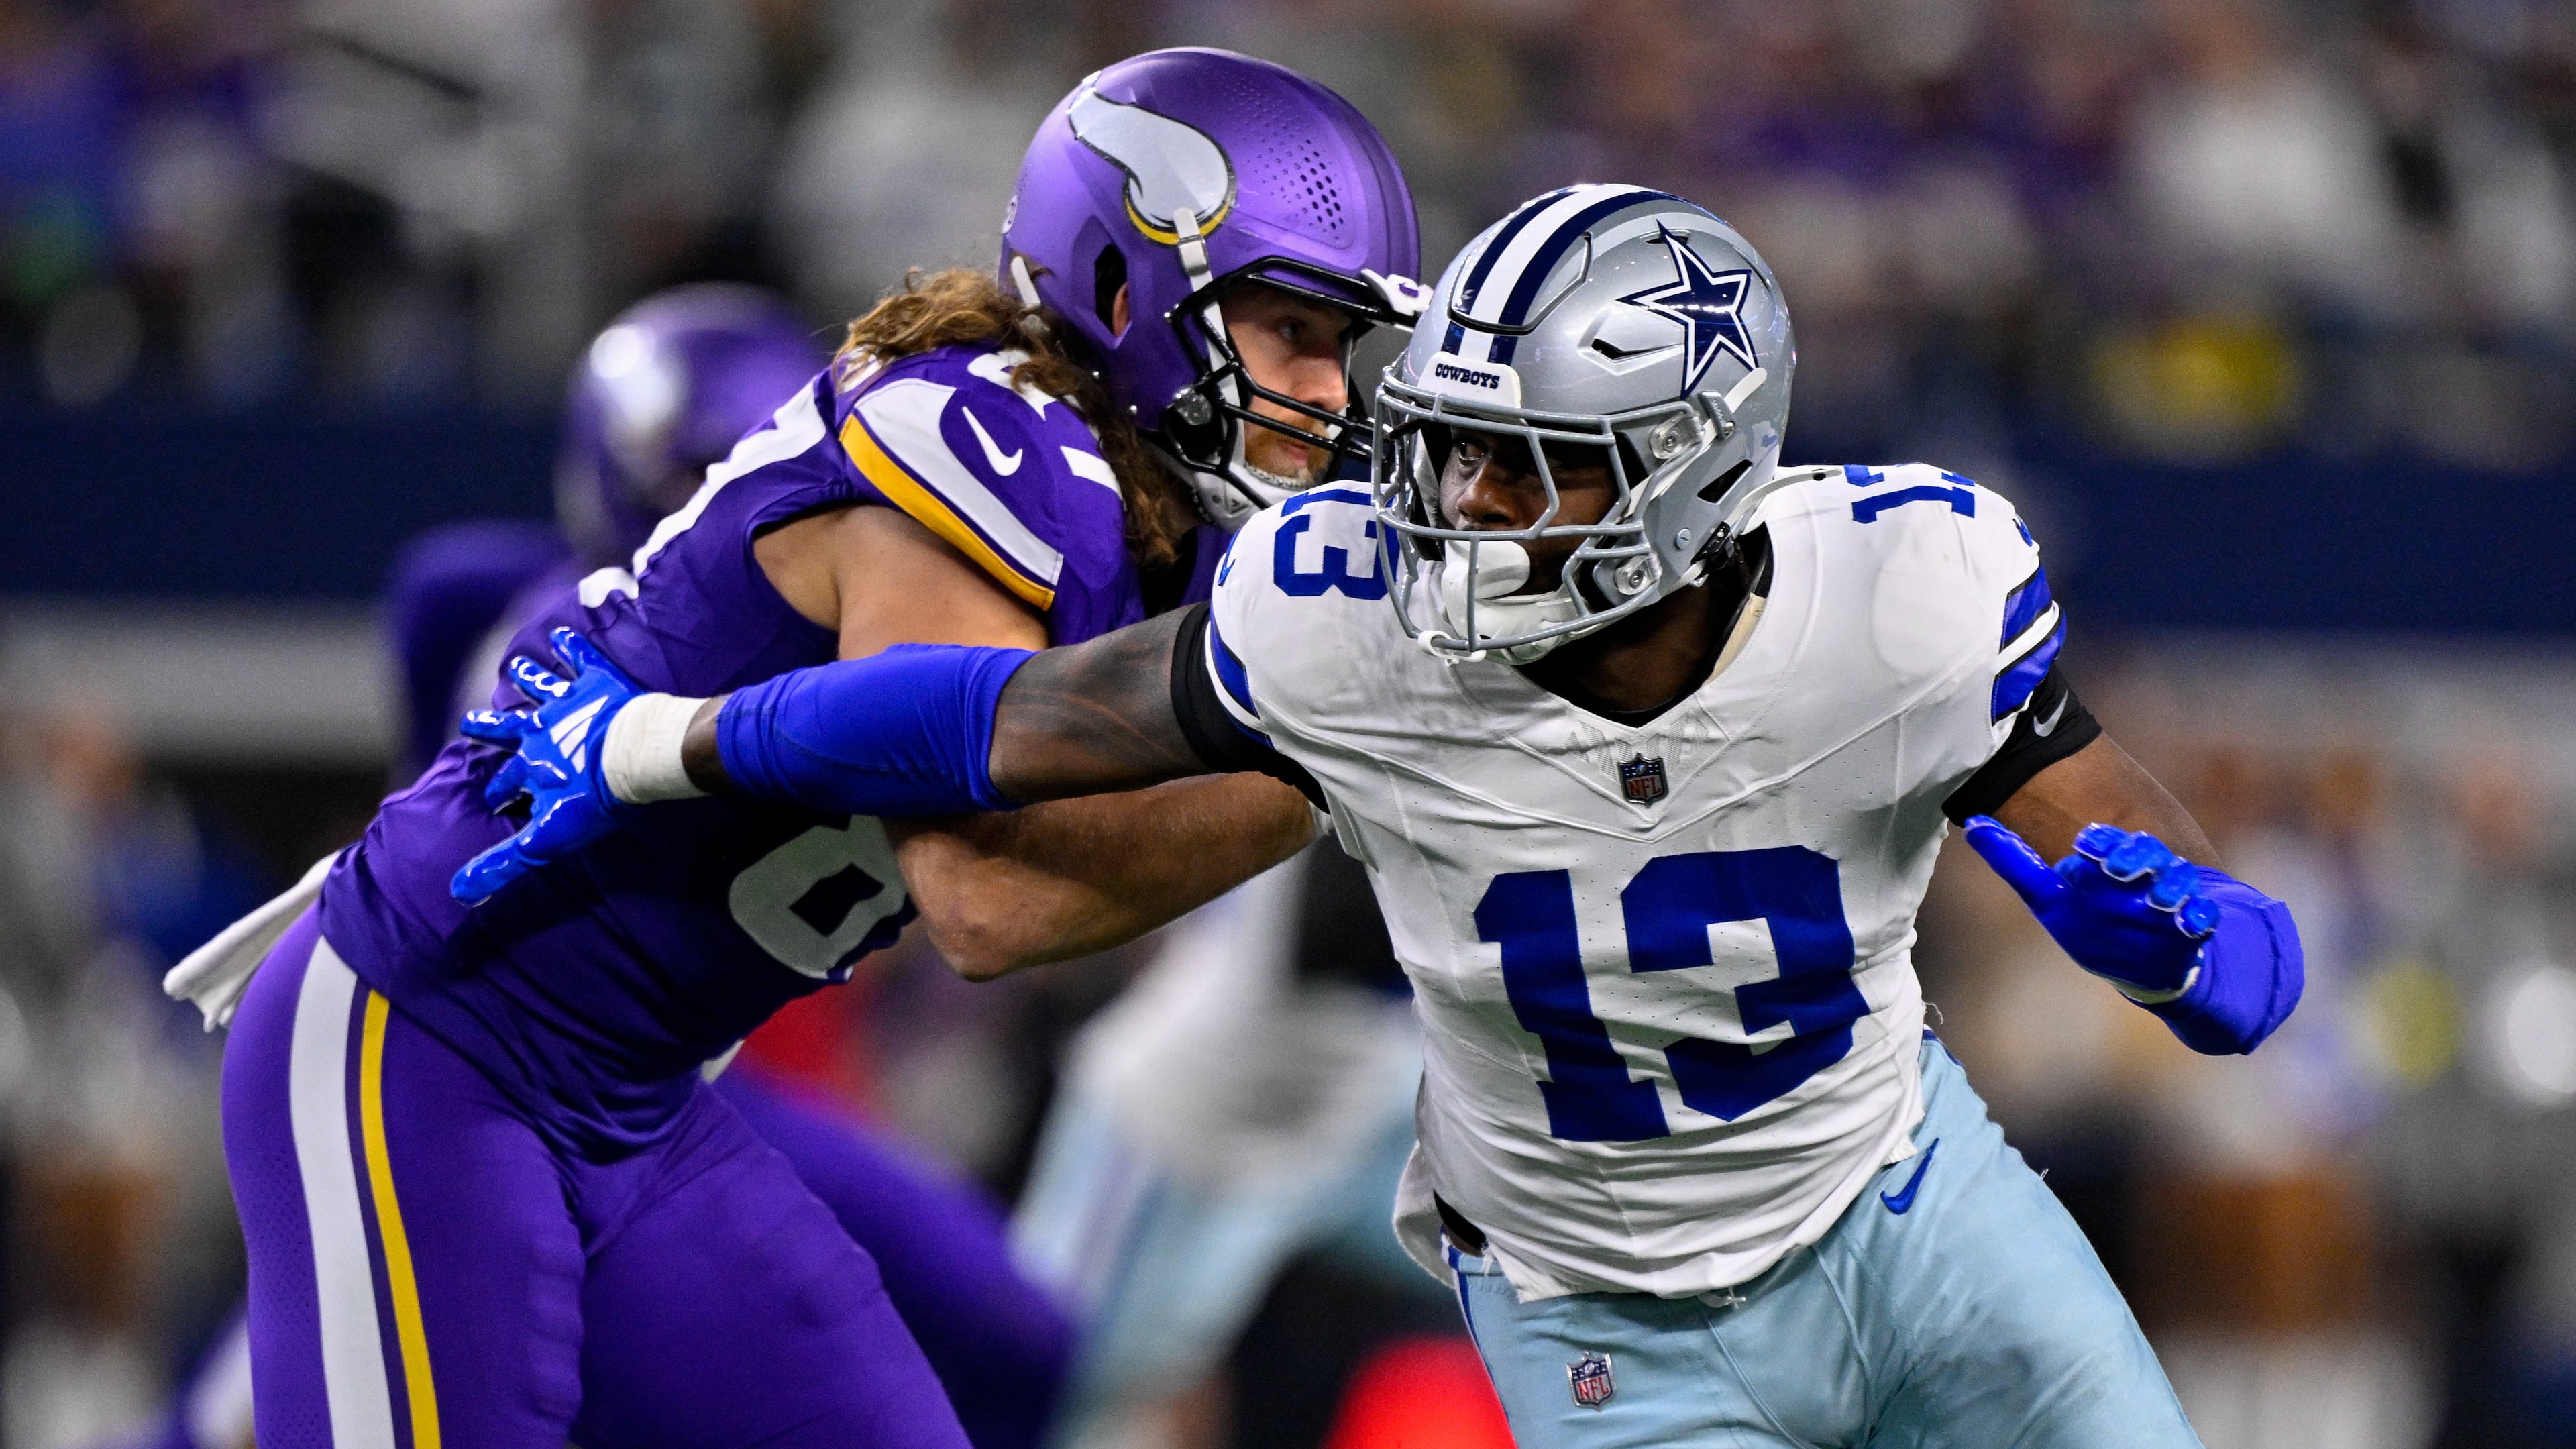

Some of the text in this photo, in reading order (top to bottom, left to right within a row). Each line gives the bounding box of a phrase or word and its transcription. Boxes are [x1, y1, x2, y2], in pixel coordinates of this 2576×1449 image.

[1436, 363, 1500, 389] COWBOYS
[1273, 489, 1402, 600] 13
[1627, 777, 1661, 798] NFL
[1474, 845, 1871, 1141] 13
[1577, 1376, 1610, 1401] NFL
